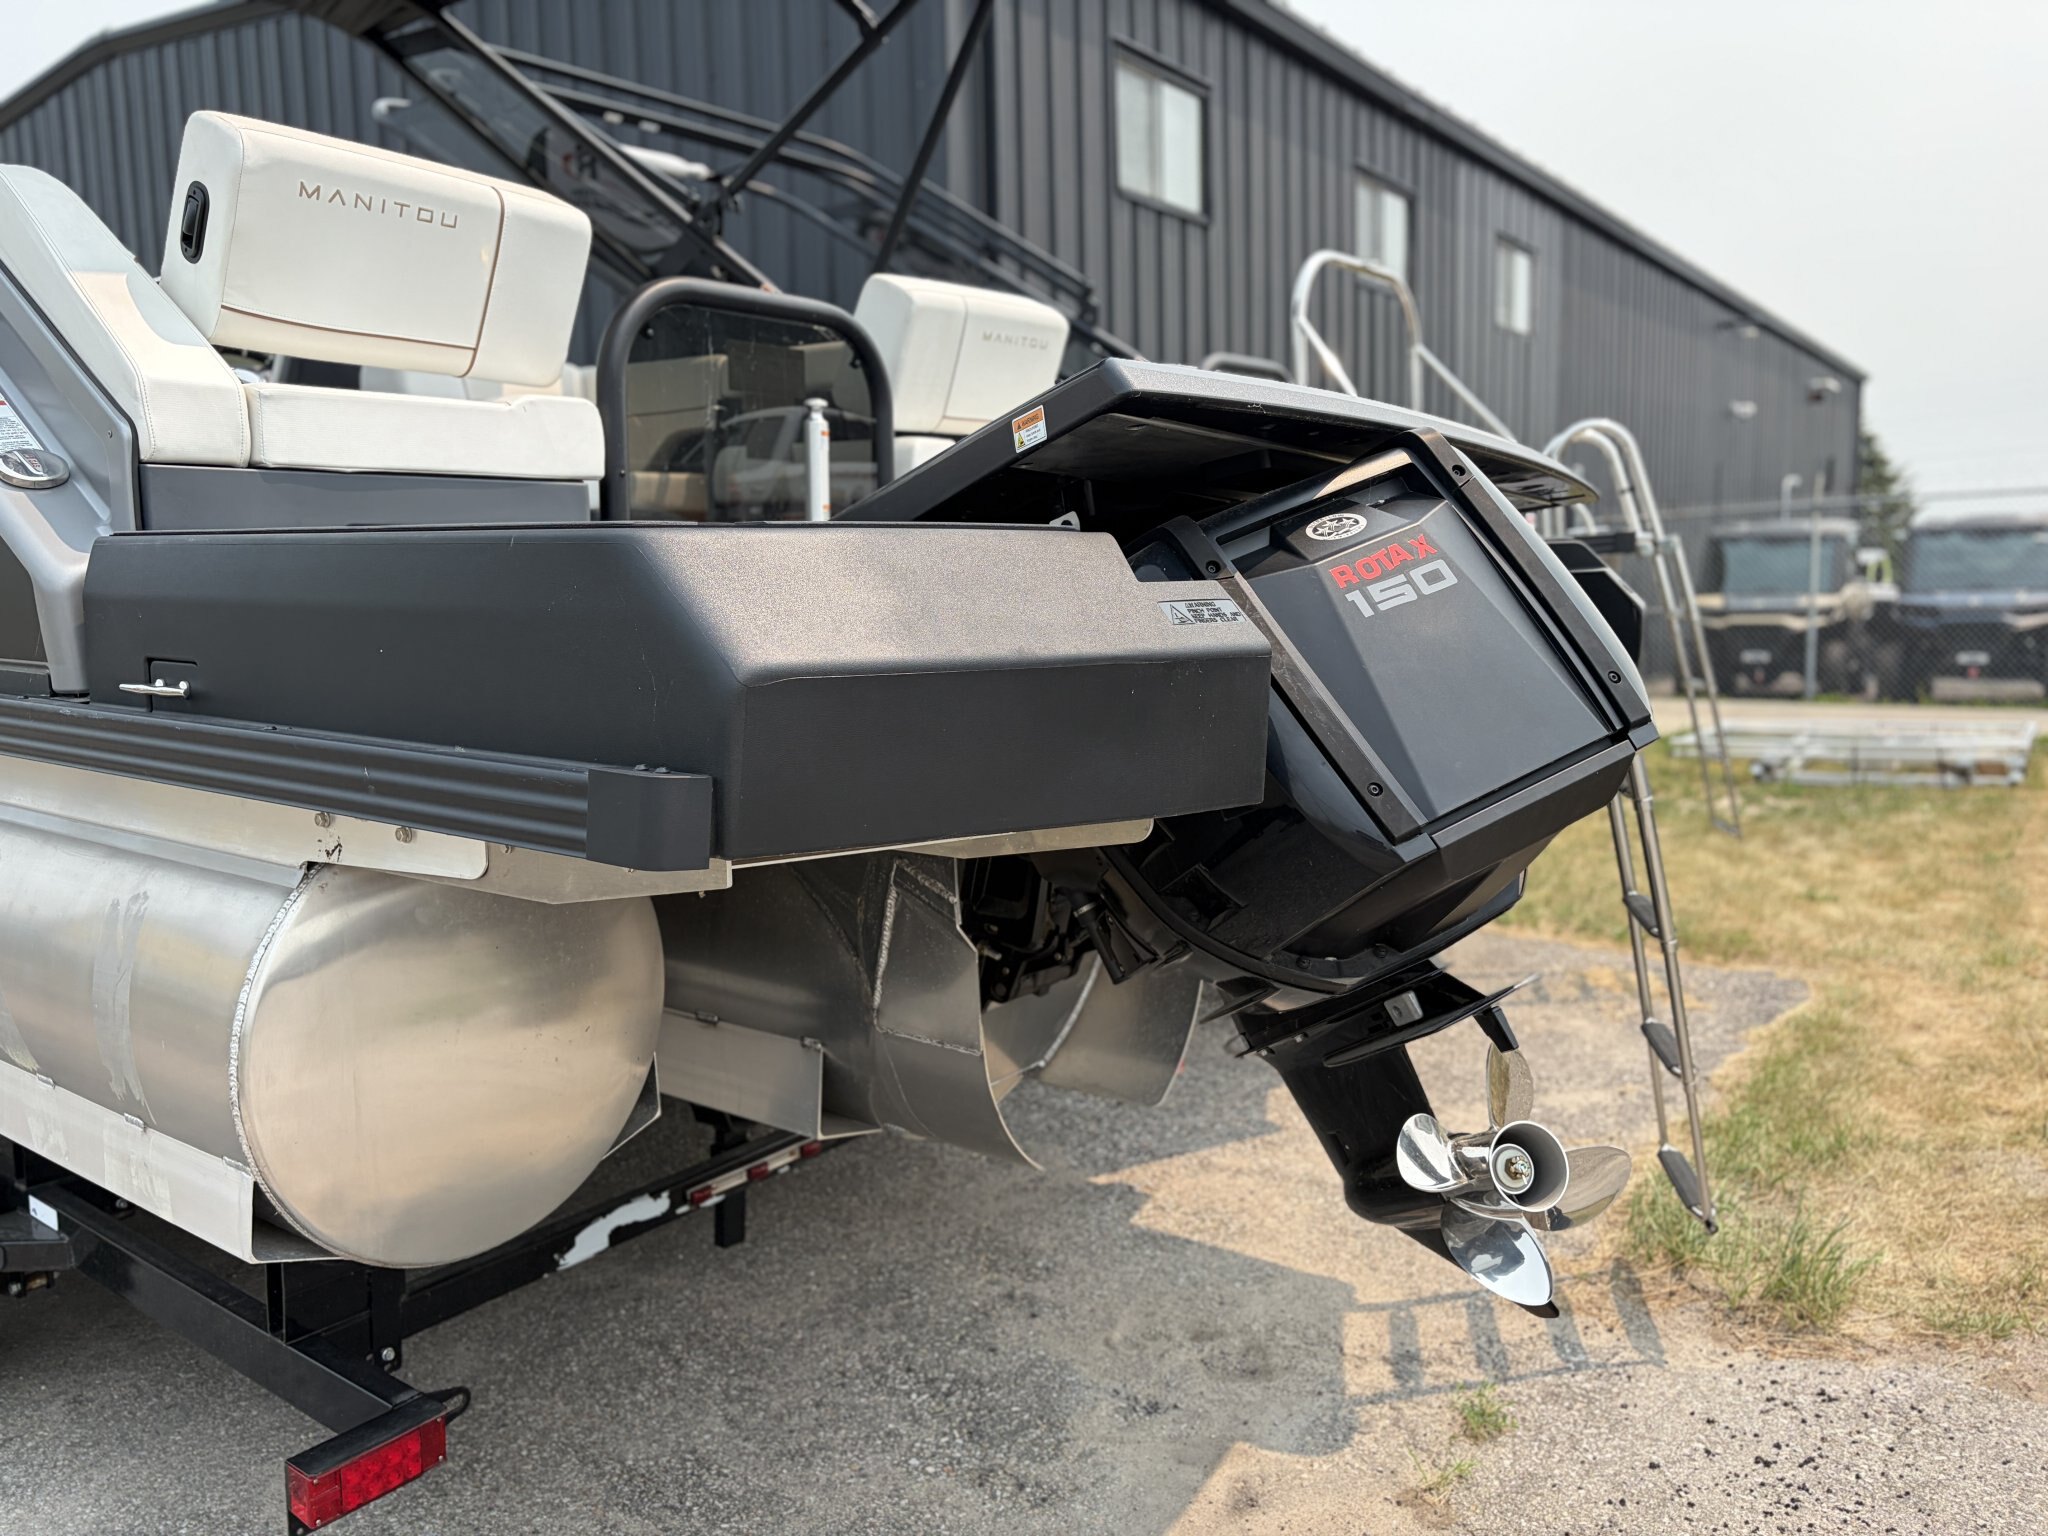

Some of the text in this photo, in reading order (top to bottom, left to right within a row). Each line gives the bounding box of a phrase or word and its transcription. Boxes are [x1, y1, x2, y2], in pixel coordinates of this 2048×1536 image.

[299, 181, 458, 229] MANITOU
[983, 331, 1049, 350] MANITOU
[1345, 559, 1458, 618] 150
